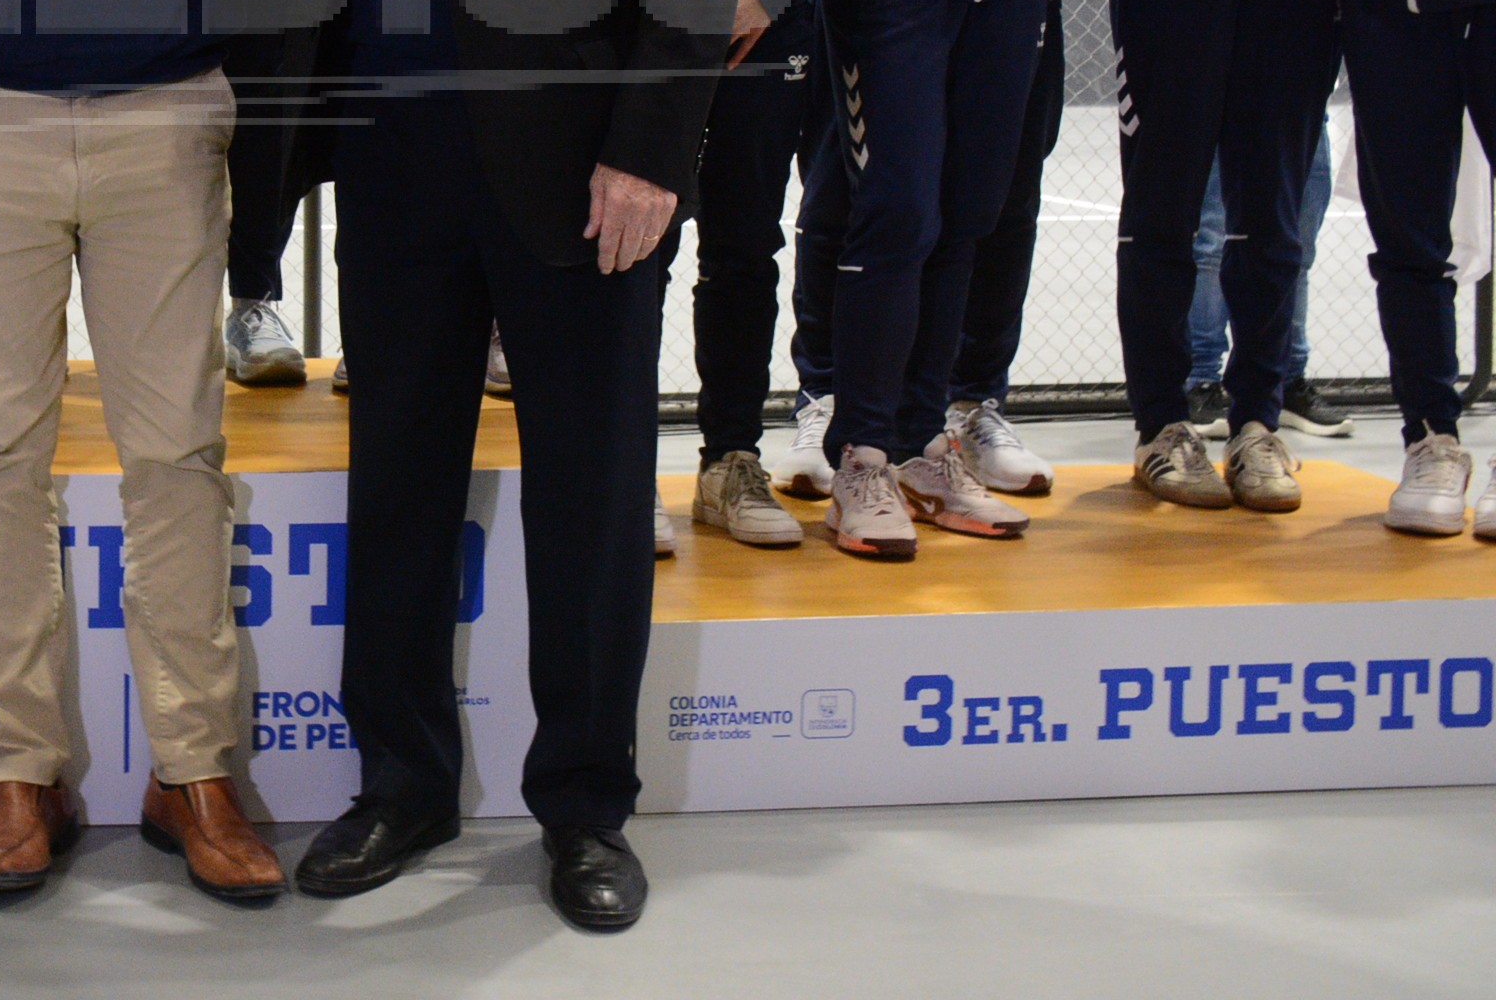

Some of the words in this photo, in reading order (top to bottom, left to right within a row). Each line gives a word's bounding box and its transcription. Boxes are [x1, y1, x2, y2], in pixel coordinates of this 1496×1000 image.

[252, 690, 345, 719] FRON
[669, 695, 738, 710] COLONIA
[902, 674, 1068, 748] 3ER.
[1097, 656, 1493, 740] PUESTO
[669, 711, 793, 728] DEPARTAMENTO
[252, 724, 297, 751] DE
[669, 729, 700, 741] Cerca
[702, 728, 717, 740] de
[720, 728, 751, 740] todos
